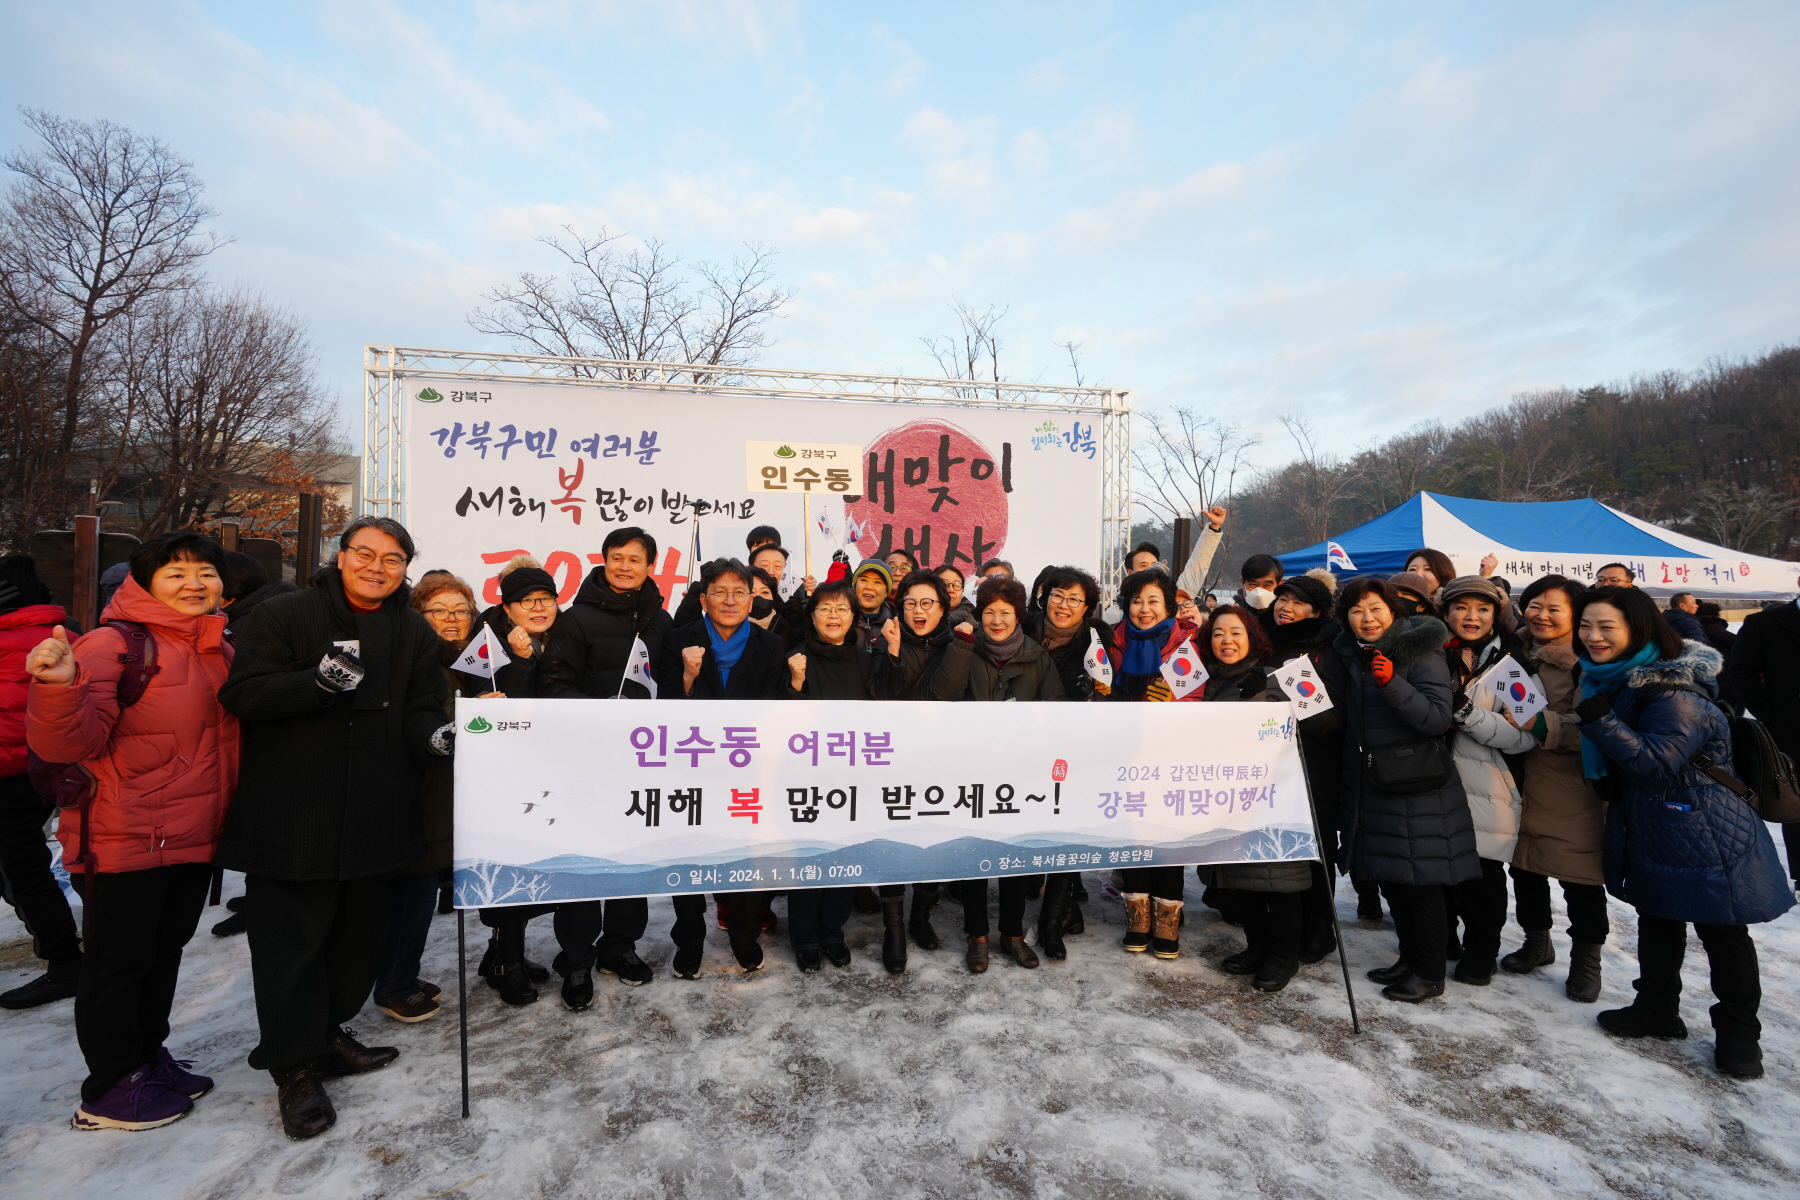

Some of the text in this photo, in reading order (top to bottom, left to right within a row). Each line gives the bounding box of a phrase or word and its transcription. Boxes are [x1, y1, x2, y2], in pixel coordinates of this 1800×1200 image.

[449, 390, 493, 403] 강북구
[429, 420, 662, 466] 강북구민 여러분
[800, 448, 837, 460] 강북구
[1062, 421, 1097, 460] 강북
[455, 485, 546, 523] 새해
[550, 457, 588, 526] 복
[595, 487, 654, 522] 많이
[760, 465, 852, 492] 인수동
[480, 547, 689, 611] 204
[1505, 560, 1534, 577] 새해
[1571, 561, 1594, 581] 기념
[1661, 561, 1691, 584] 소망
[1703, 563, 1736, 585] 적기
[496, 721, 532, 731] 강북구
[629, 725, 894, 768] 인수동 여러분
[1117, 764, 1269, 783] 2024 갑진년(甲辰年)
[624, 787, 703, 828] 새해
[726, 788, 763, 824] 복
[785, 786, 858, 824] 많이
[1097, 783, 1277, 819] 강북 해맞이행사
[998, 849, 1154, 870] 장소: 북서울꿈의숲 청운답원
[689, 869, 722, 885] 일시:
[728, 868, 764, 883] 2024.
[771, 868, 782, 880] 1.
[828, 864, 862, 879] 07:00
